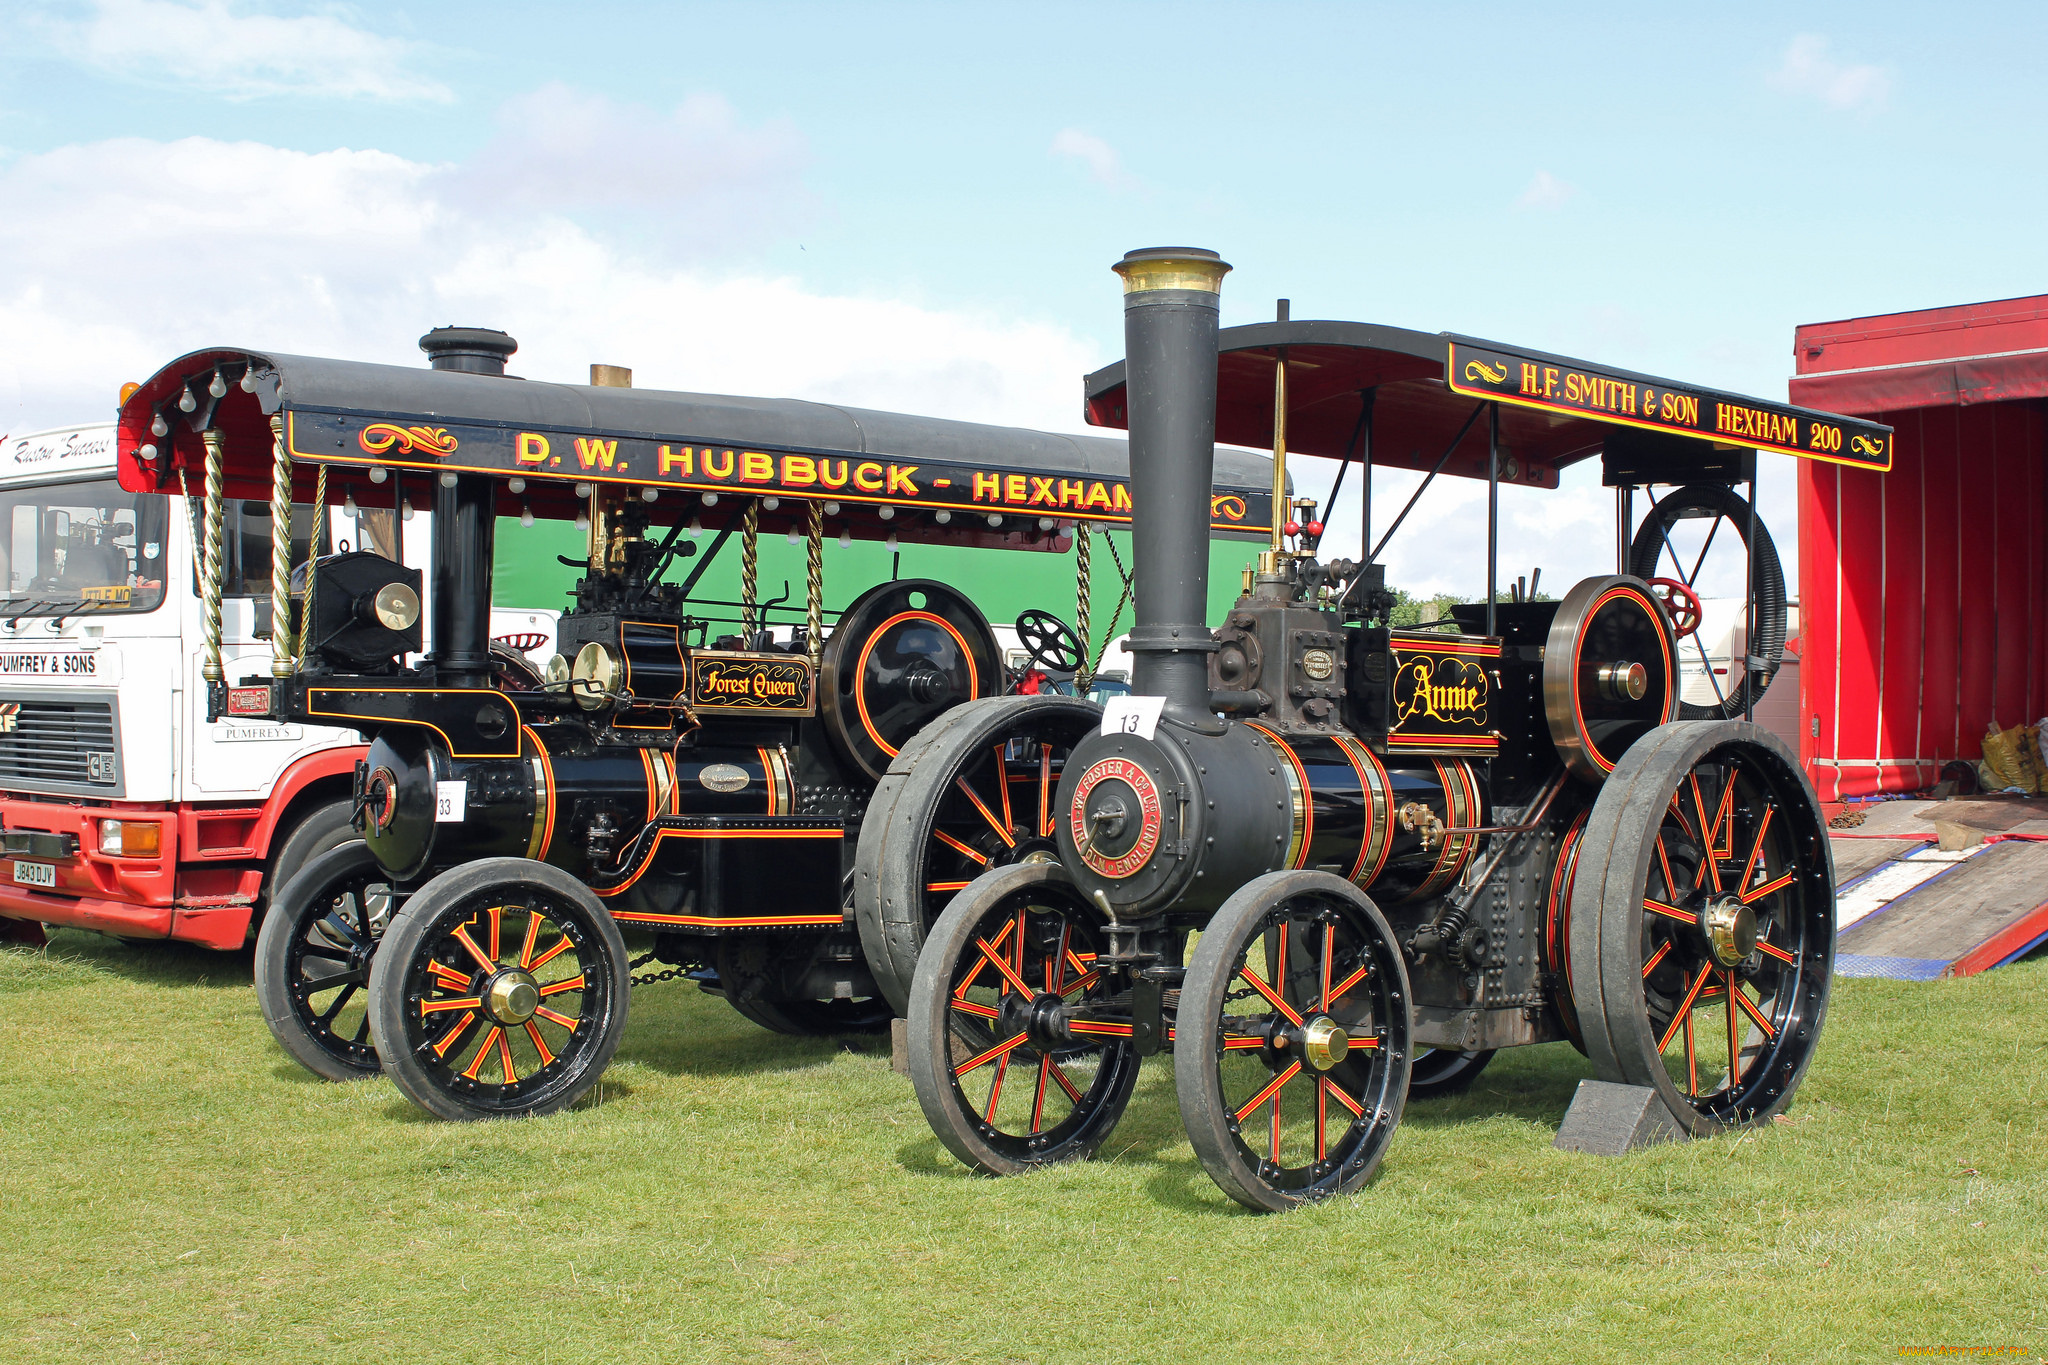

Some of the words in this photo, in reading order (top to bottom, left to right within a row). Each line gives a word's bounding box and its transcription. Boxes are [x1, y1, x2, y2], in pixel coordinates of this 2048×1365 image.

[1643, 389, 1657, 417] &
[1661, 392, 1699, 426] SON
[1716, 402, 1798, 446] HEXHAM
[1810, 422, 1842, 453] 200
[515, 432, 562, 468] D.
[573, 438, 629, 473] W.
[658, 444, 919, 496] HUBBUCK
[51, 655, 59, 673] &
[64, 655, 96, 673] SONS
[704, 670, 750, 694] Forest
[753, 672, 796, 698] Queen
[1404, 664, 1480, 719] Annie
[1120, 714, 1140, 733] 13
[226, 728, 290, 739] PUMFREY'S
[104, 762, 111, 772] E
[1082, 761, 1123, 790] FOSTER
[1125, 767, 1135, 780] &
[439, 799, 451, 815] 33
[16, 863, 35, 881] J843
